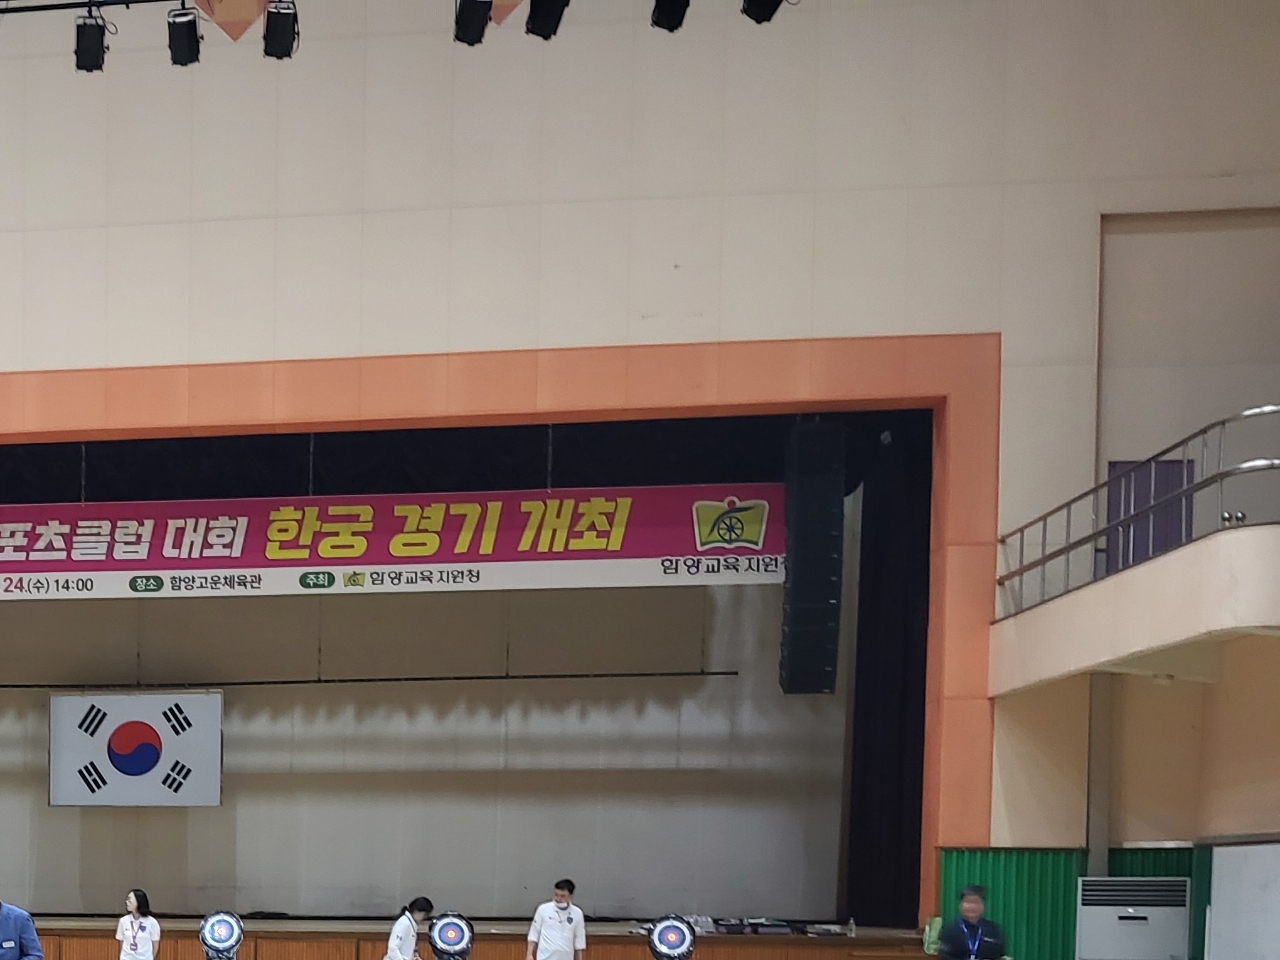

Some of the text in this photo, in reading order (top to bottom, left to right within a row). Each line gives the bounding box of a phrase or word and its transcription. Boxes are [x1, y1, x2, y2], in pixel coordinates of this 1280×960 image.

[162, 516, 249, 559] 대회
[265, 505, 374, 559] 한궁
[389, 501, 503, 557] 경기
[517, 498, 632, 553] 개최
[54, 578, 94, 592] 14:00
[135, 573, 262, 591] 장소 함양고운체육관
[306, 573, 328, 586] 주최
